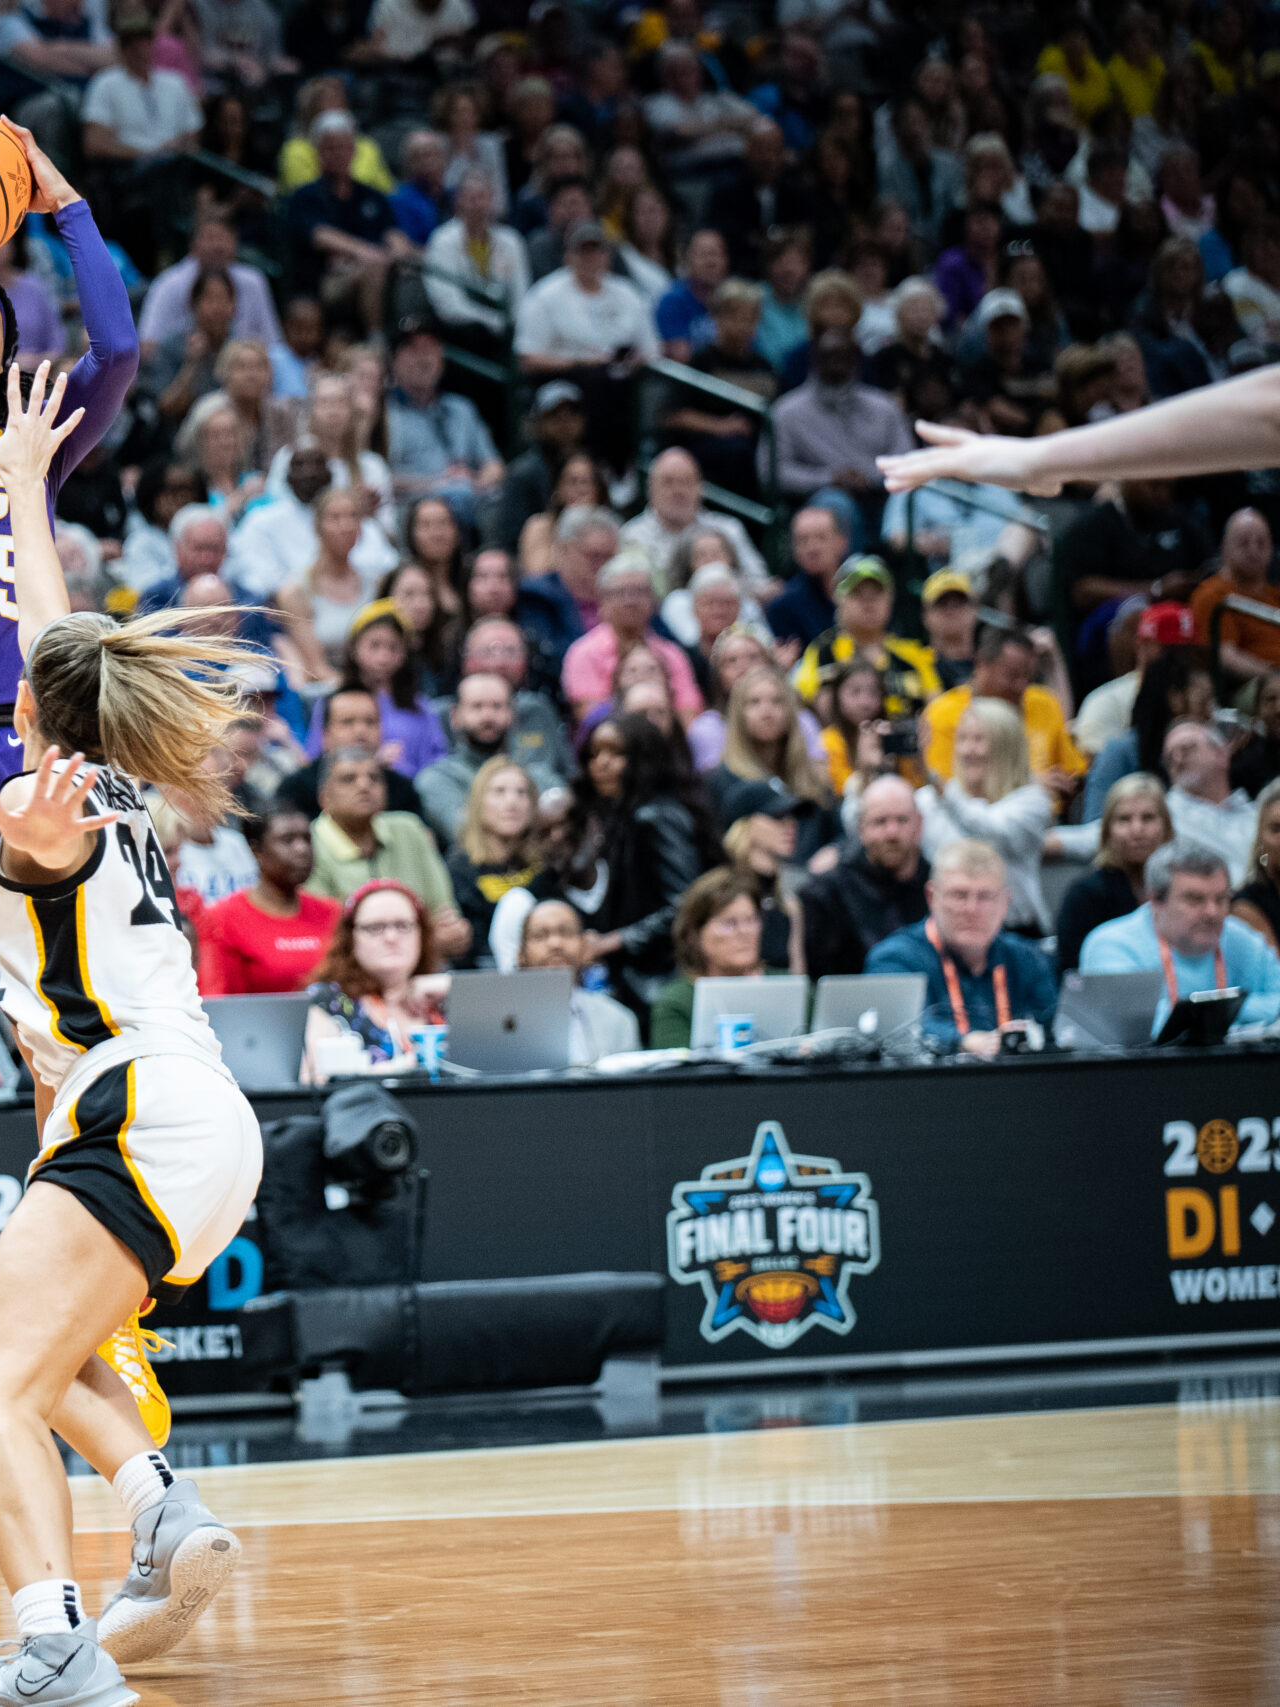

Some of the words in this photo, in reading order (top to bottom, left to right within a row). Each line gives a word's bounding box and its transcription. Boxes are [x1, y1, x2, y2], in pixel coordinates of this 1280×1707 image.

[676, 1207, 773, 1268] FINAL
[776, 1205, 869, 1258] FOUR
[1165, 1184, 1240, 1260] DI
